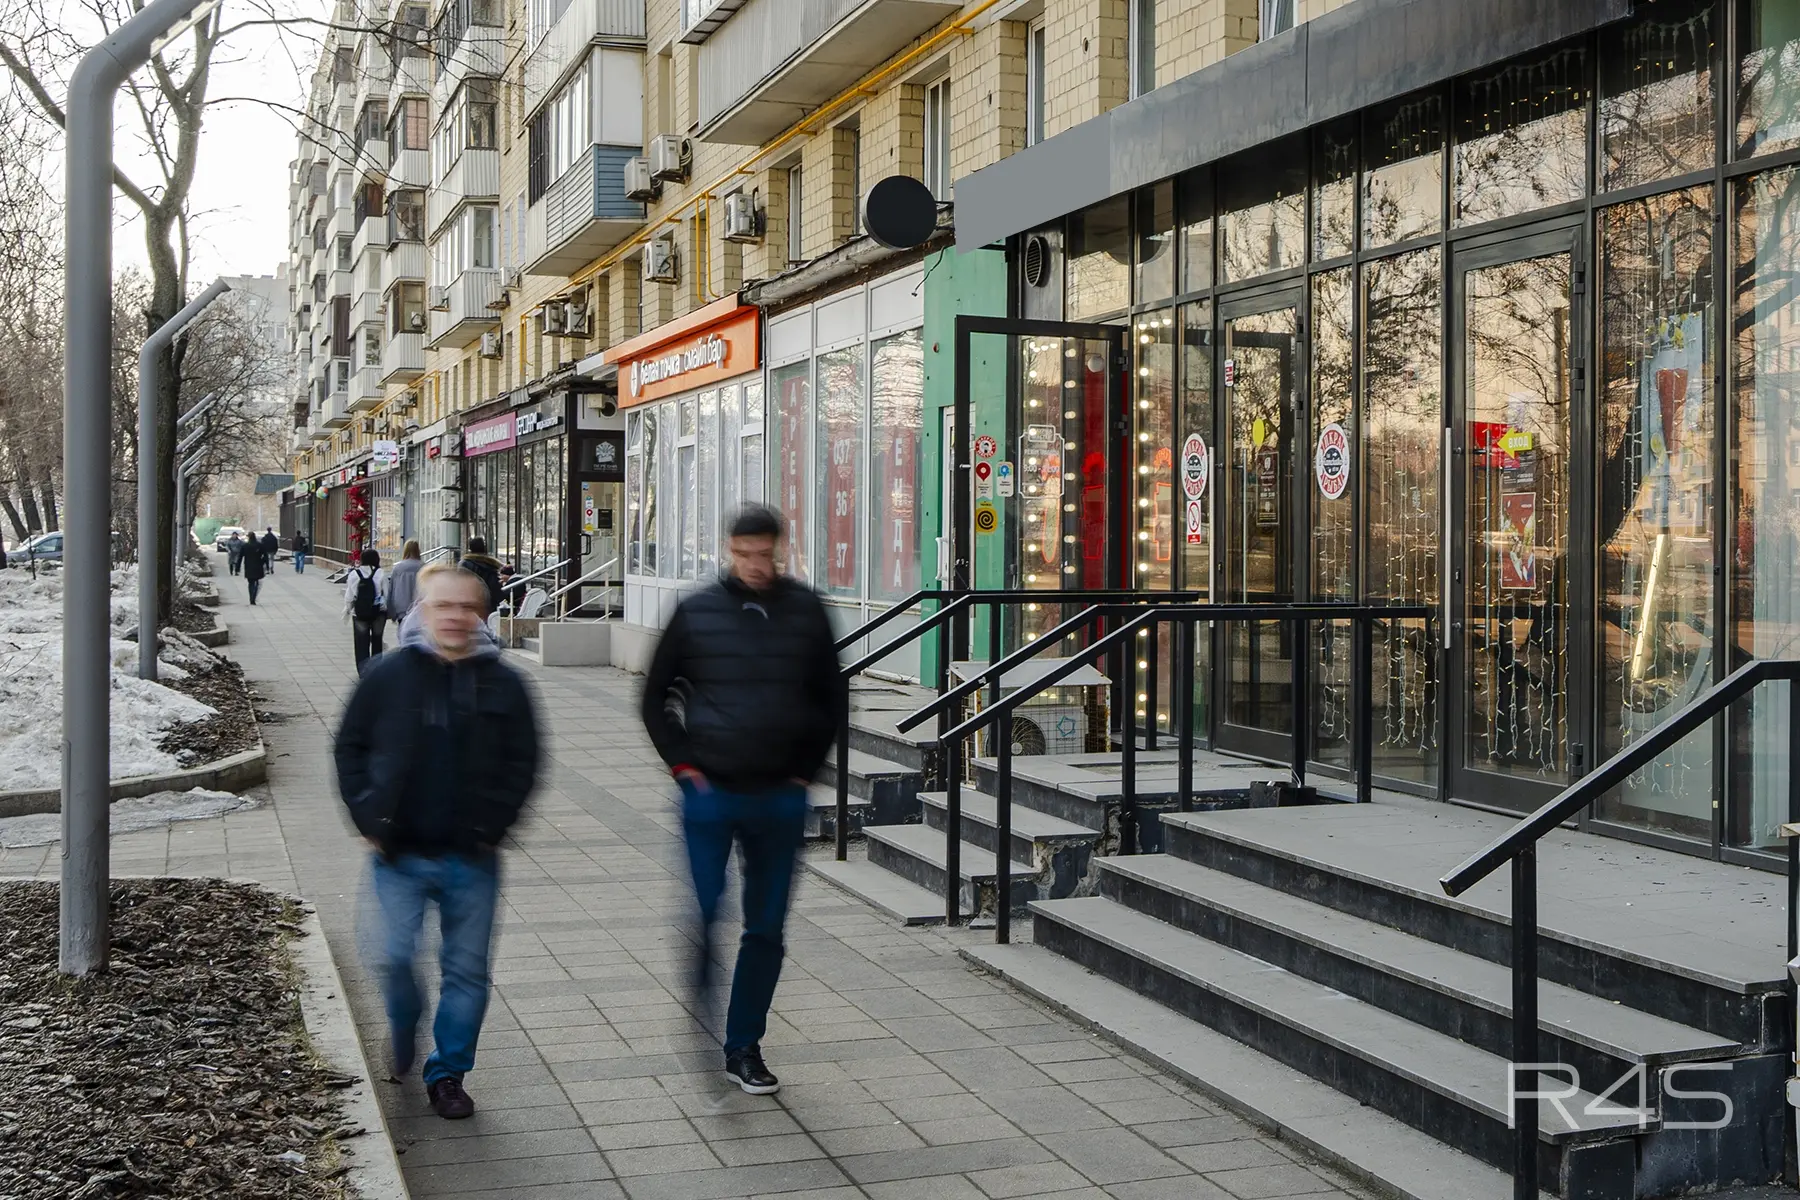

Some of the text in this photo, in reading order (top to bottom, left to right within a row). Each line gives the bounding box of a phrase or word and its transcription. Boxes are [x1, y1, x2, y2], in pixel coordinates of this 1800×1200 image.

[683, 333, 723, 371] смайл бар
[660, 353, 680, 379] точка
[1508, 435, 1529, 449] ВХОД
[835, 490, 848, 517] 36
[835, 542, 848, 569] 37
